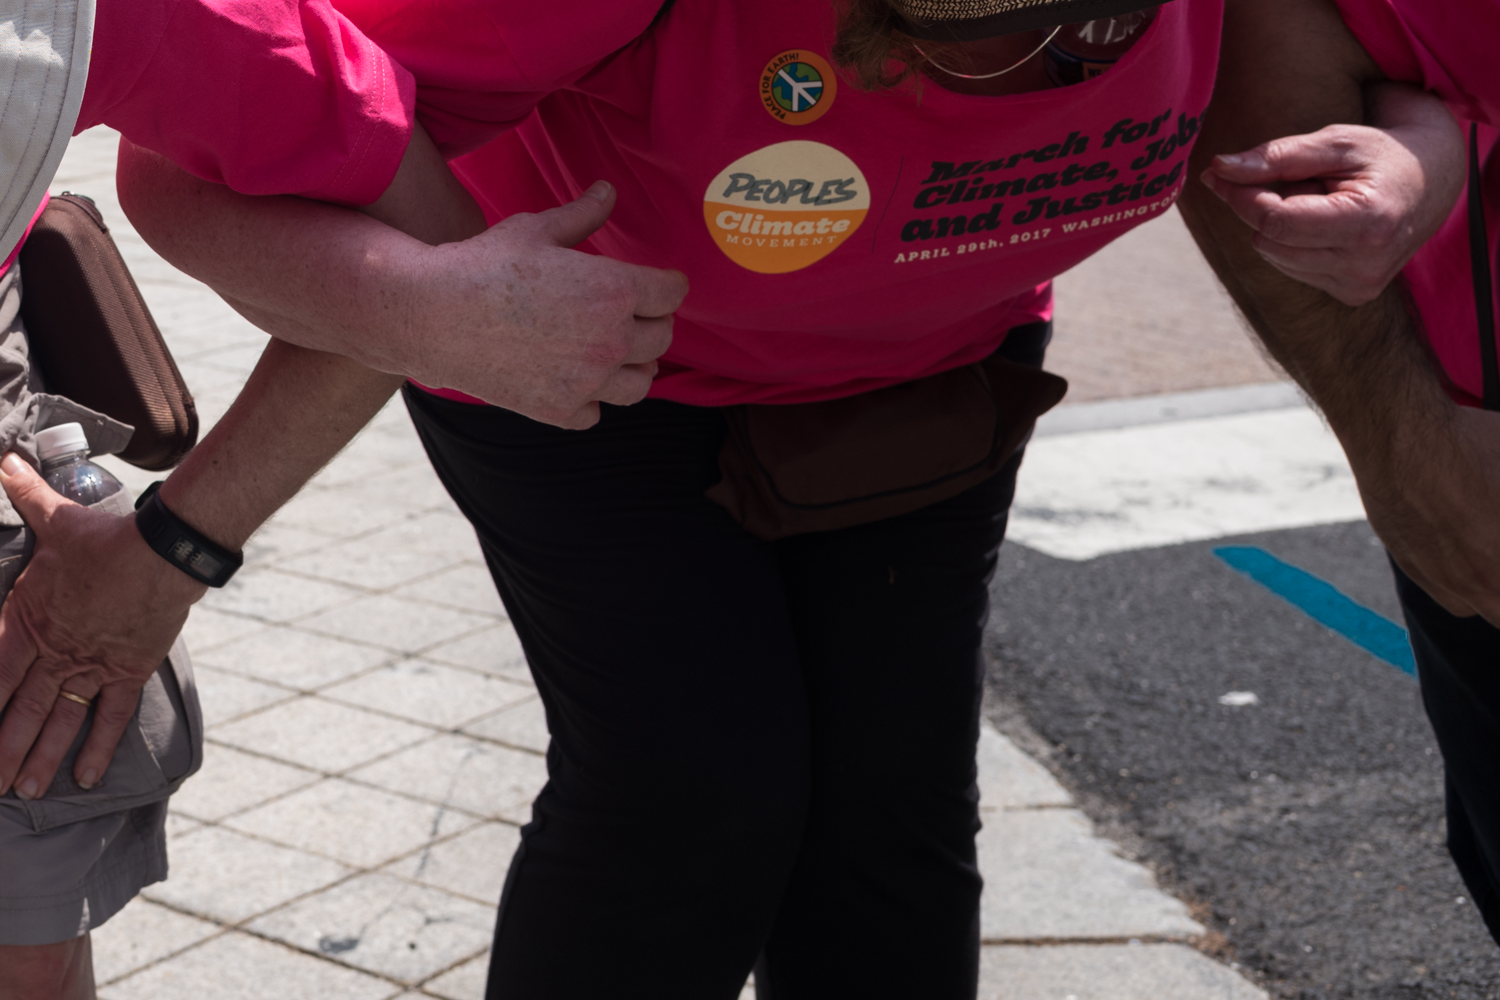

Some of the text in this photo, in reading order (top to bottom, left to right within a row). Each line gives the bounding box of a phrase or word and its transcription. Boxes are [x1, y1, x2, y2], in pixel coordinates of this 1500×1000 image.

[762, 53, 799, 119] PEACE FOR EARTH!
[920, 107, 1172, 185] March for
[722, 172, 857, 206] PEOPLES
[901, 160, 1184, 242] and Justice
[913, 161, 1119, 209] Climate,
[715, 211, 851, 236] Climate
[726, 234, 836, 248] MOVEMENT
[894, 247, 950, 263] APRIL
[1009, 228, 1051, 244] 2017
[1062, 187, 1179, 233] WASHINGTON
